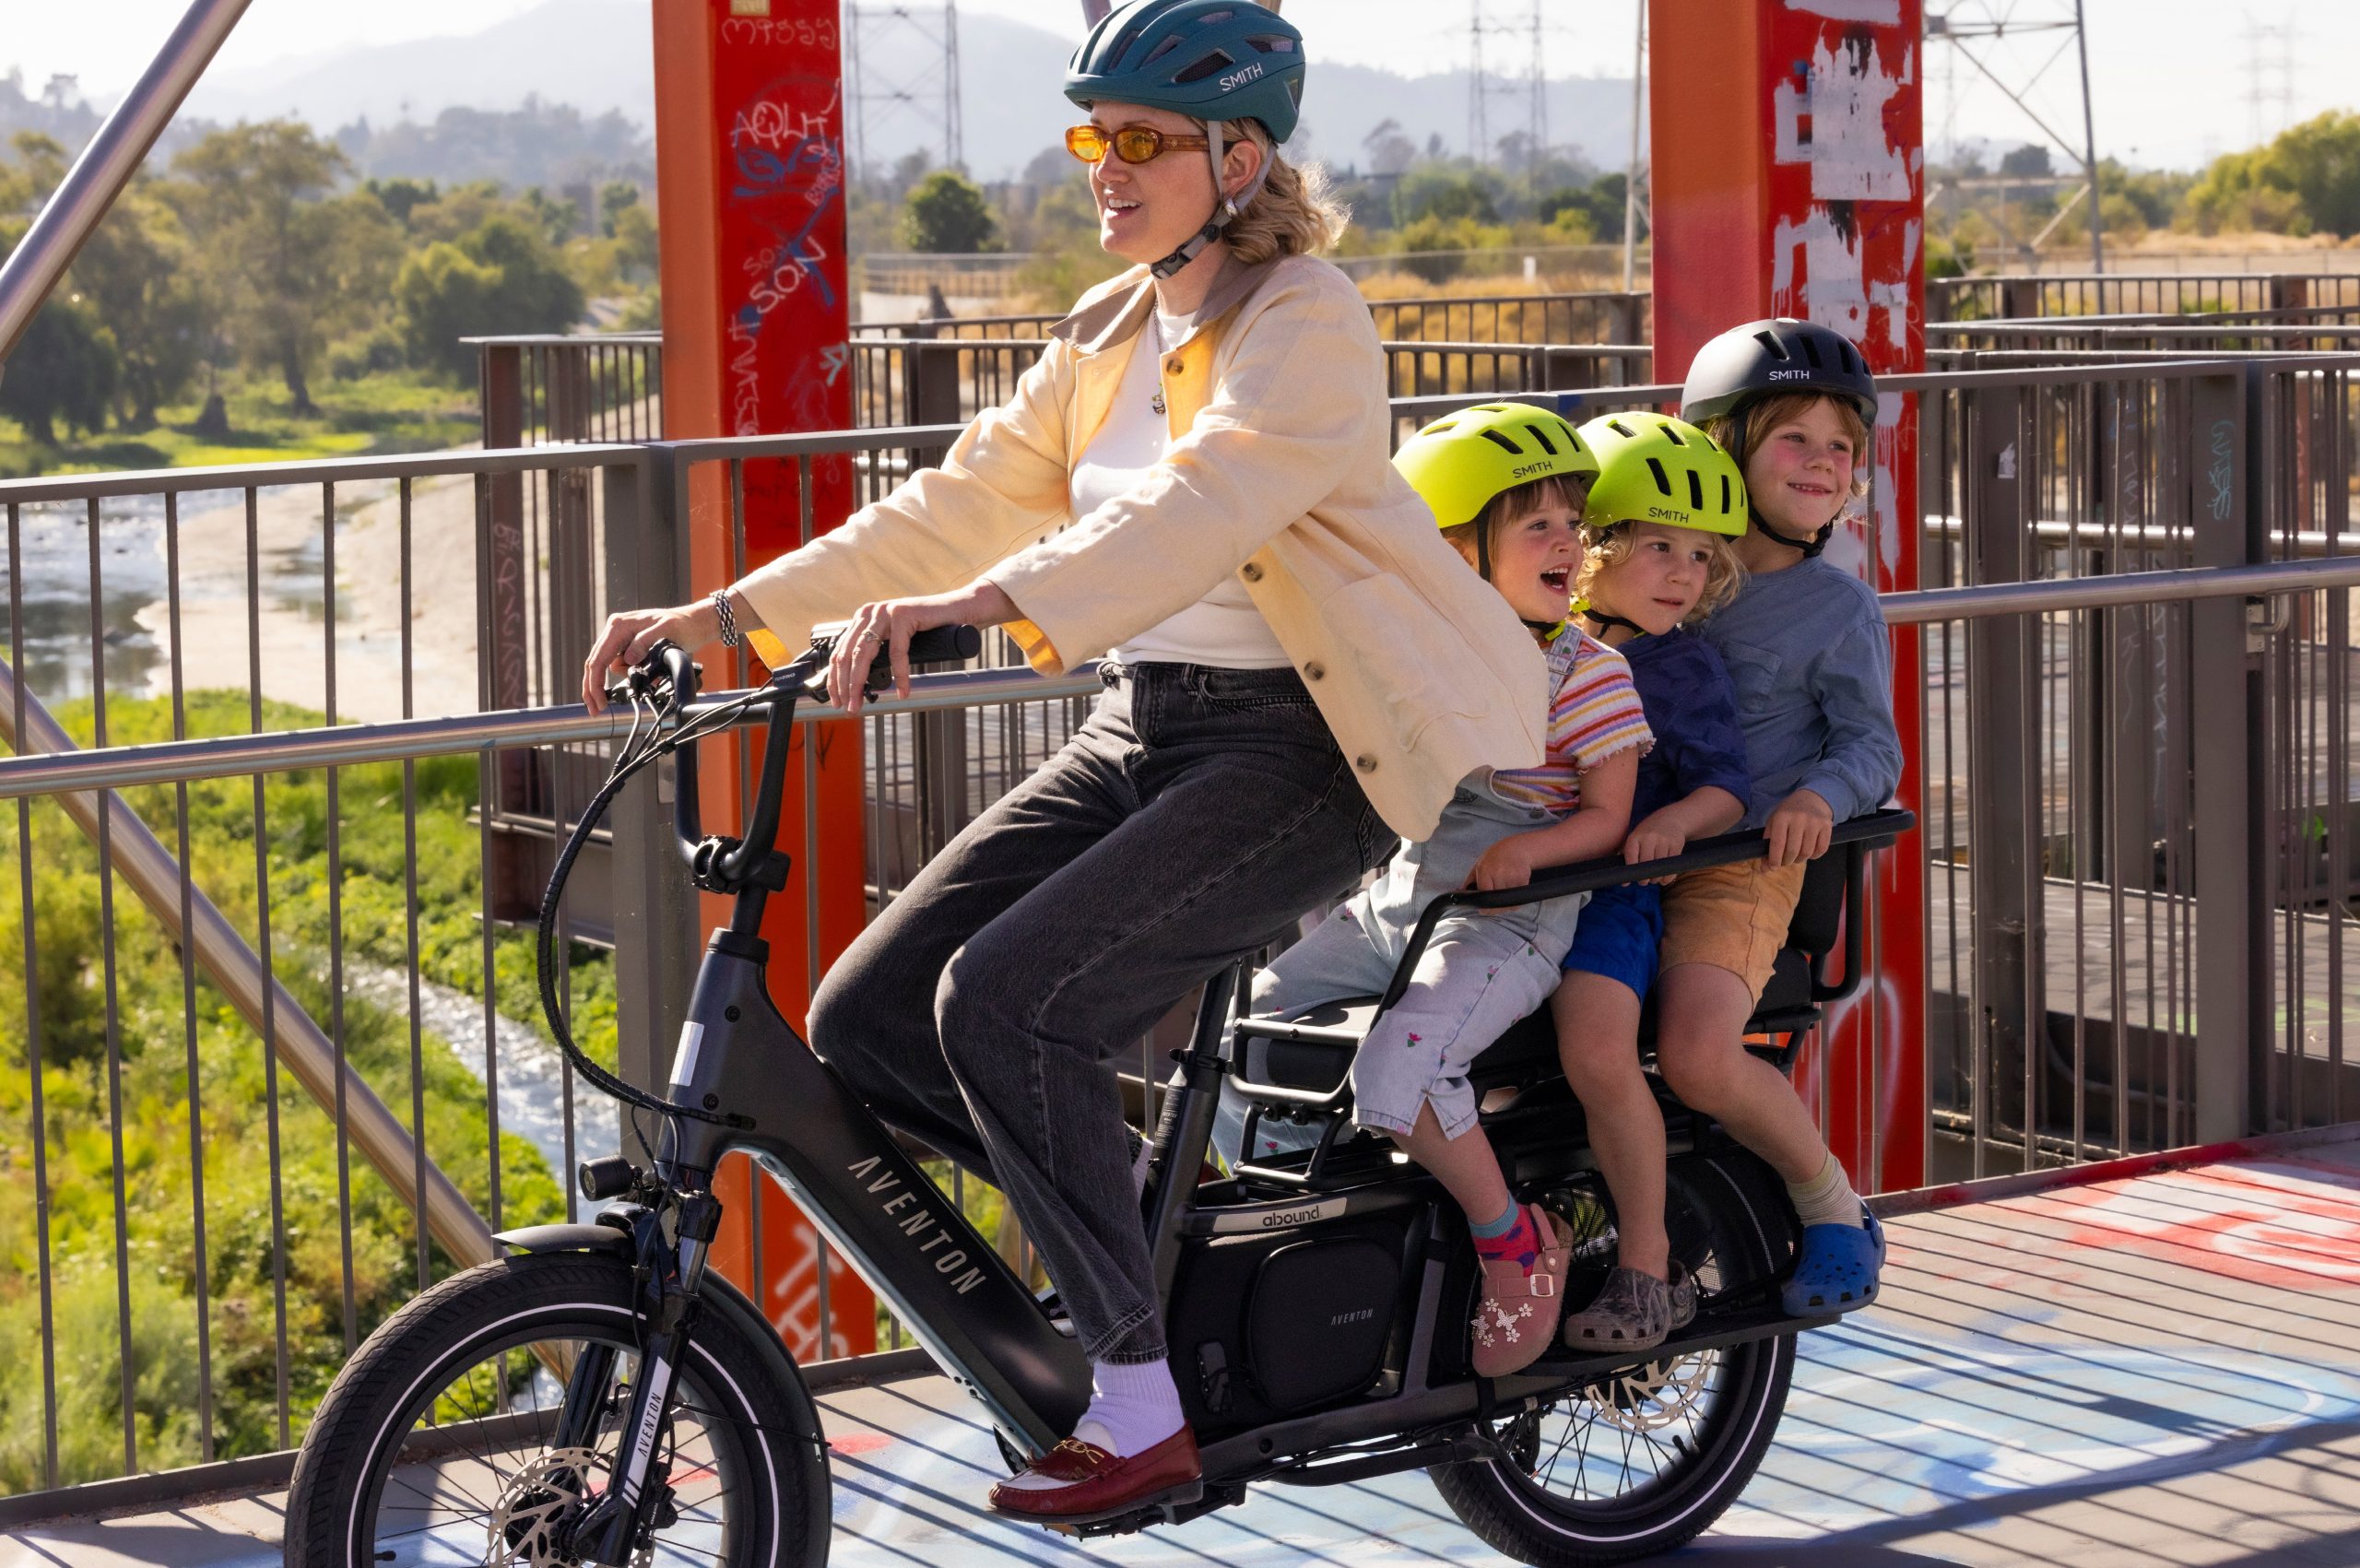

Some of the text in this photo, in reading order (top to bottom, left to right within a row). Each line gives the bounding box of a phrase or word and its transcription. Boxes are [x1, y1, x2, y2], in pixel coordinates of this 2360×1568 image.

[1219, 62, 1263, 92] SMITH
[1768, 370, 1811, 381] SMITH
[1512, 459, 1554, 479] SMITH
[1646, 505, 1690, 525] SMITH
[847, 1155, 987, 1296] AVENTON
[1262, 1205, 1320, 1227] abound
[1330, 1307, 1374, 1326] AVENTON
[637, 1392, 663, 1458] AVENTON
